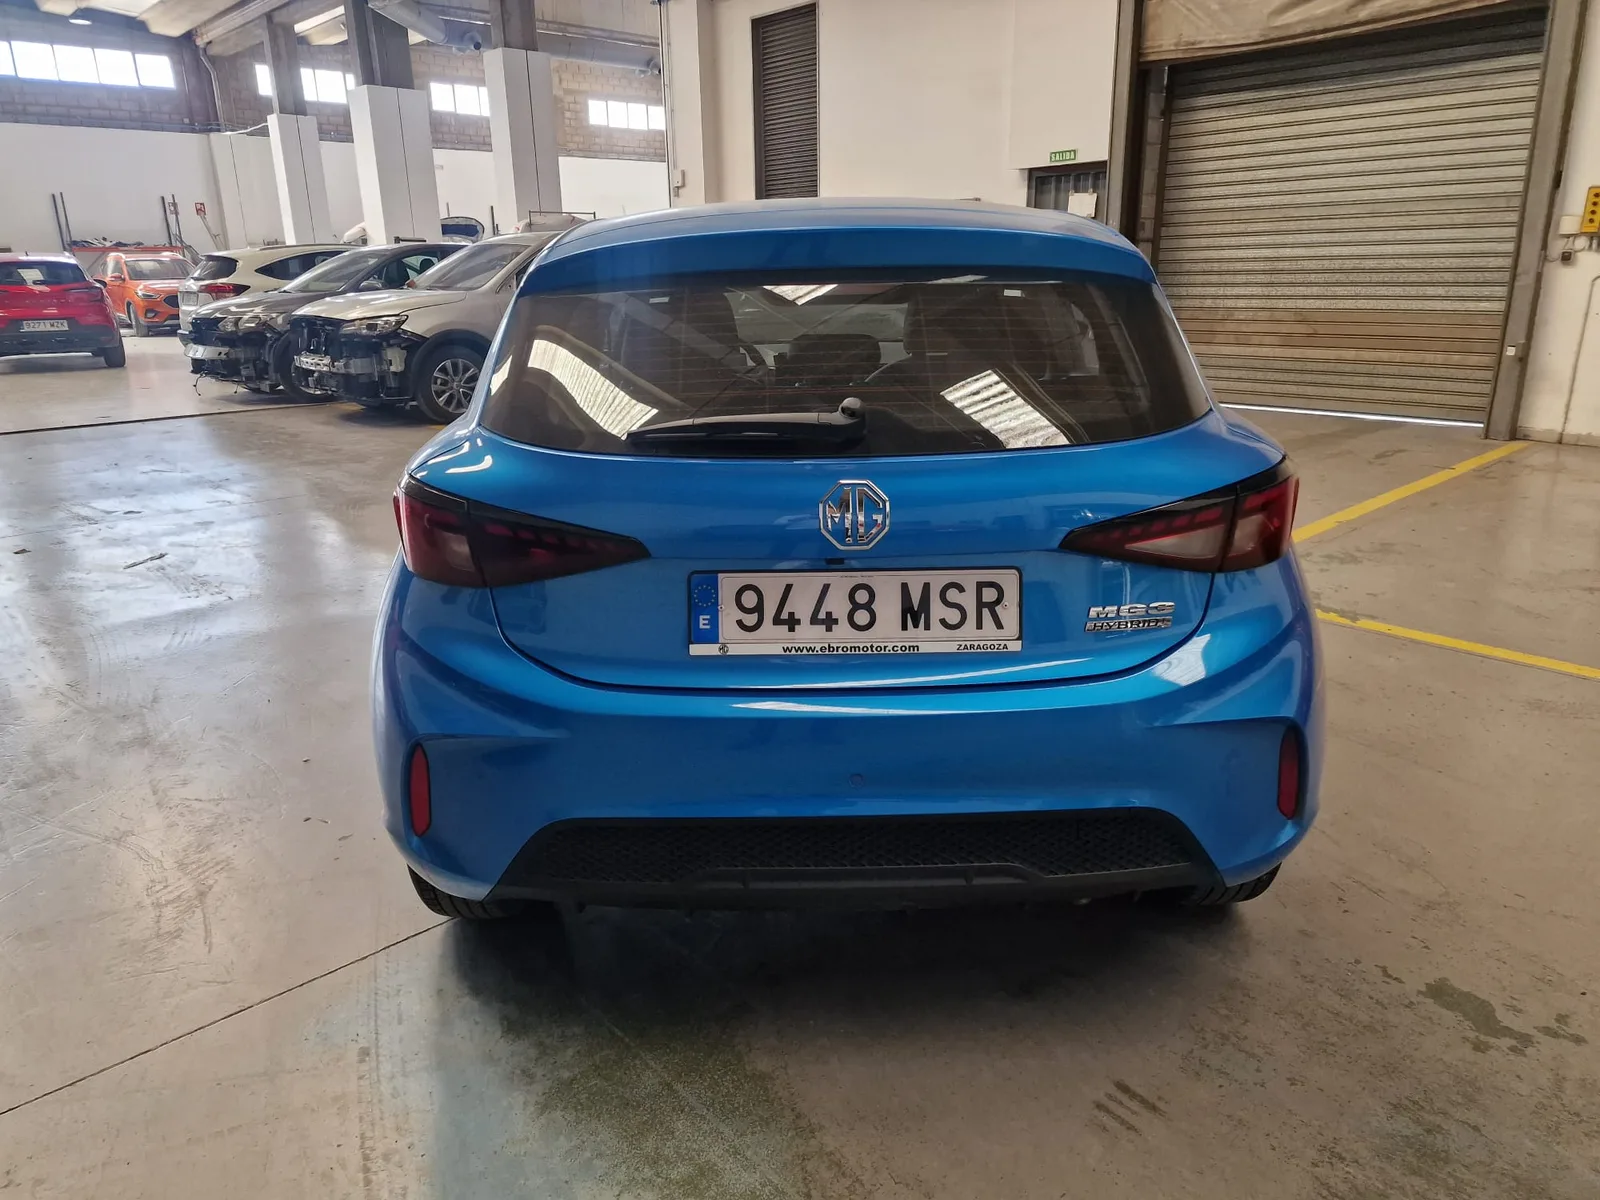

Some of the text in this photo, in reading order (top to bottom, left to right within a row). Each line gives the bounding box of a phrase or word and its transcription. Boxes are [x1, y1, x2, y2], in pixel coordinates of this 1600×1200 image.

[1051, 152, 1075, 161] SALIDA
[826, 487, 883, 543] MG
[734, 580, 1005, 633] 9448 MSR
[1088, 602, 1175, 618] MG3
[699, 615, 710, 629] E
[782, 643, 1009, 653] www.ebromotor.com ZARAGOZA
